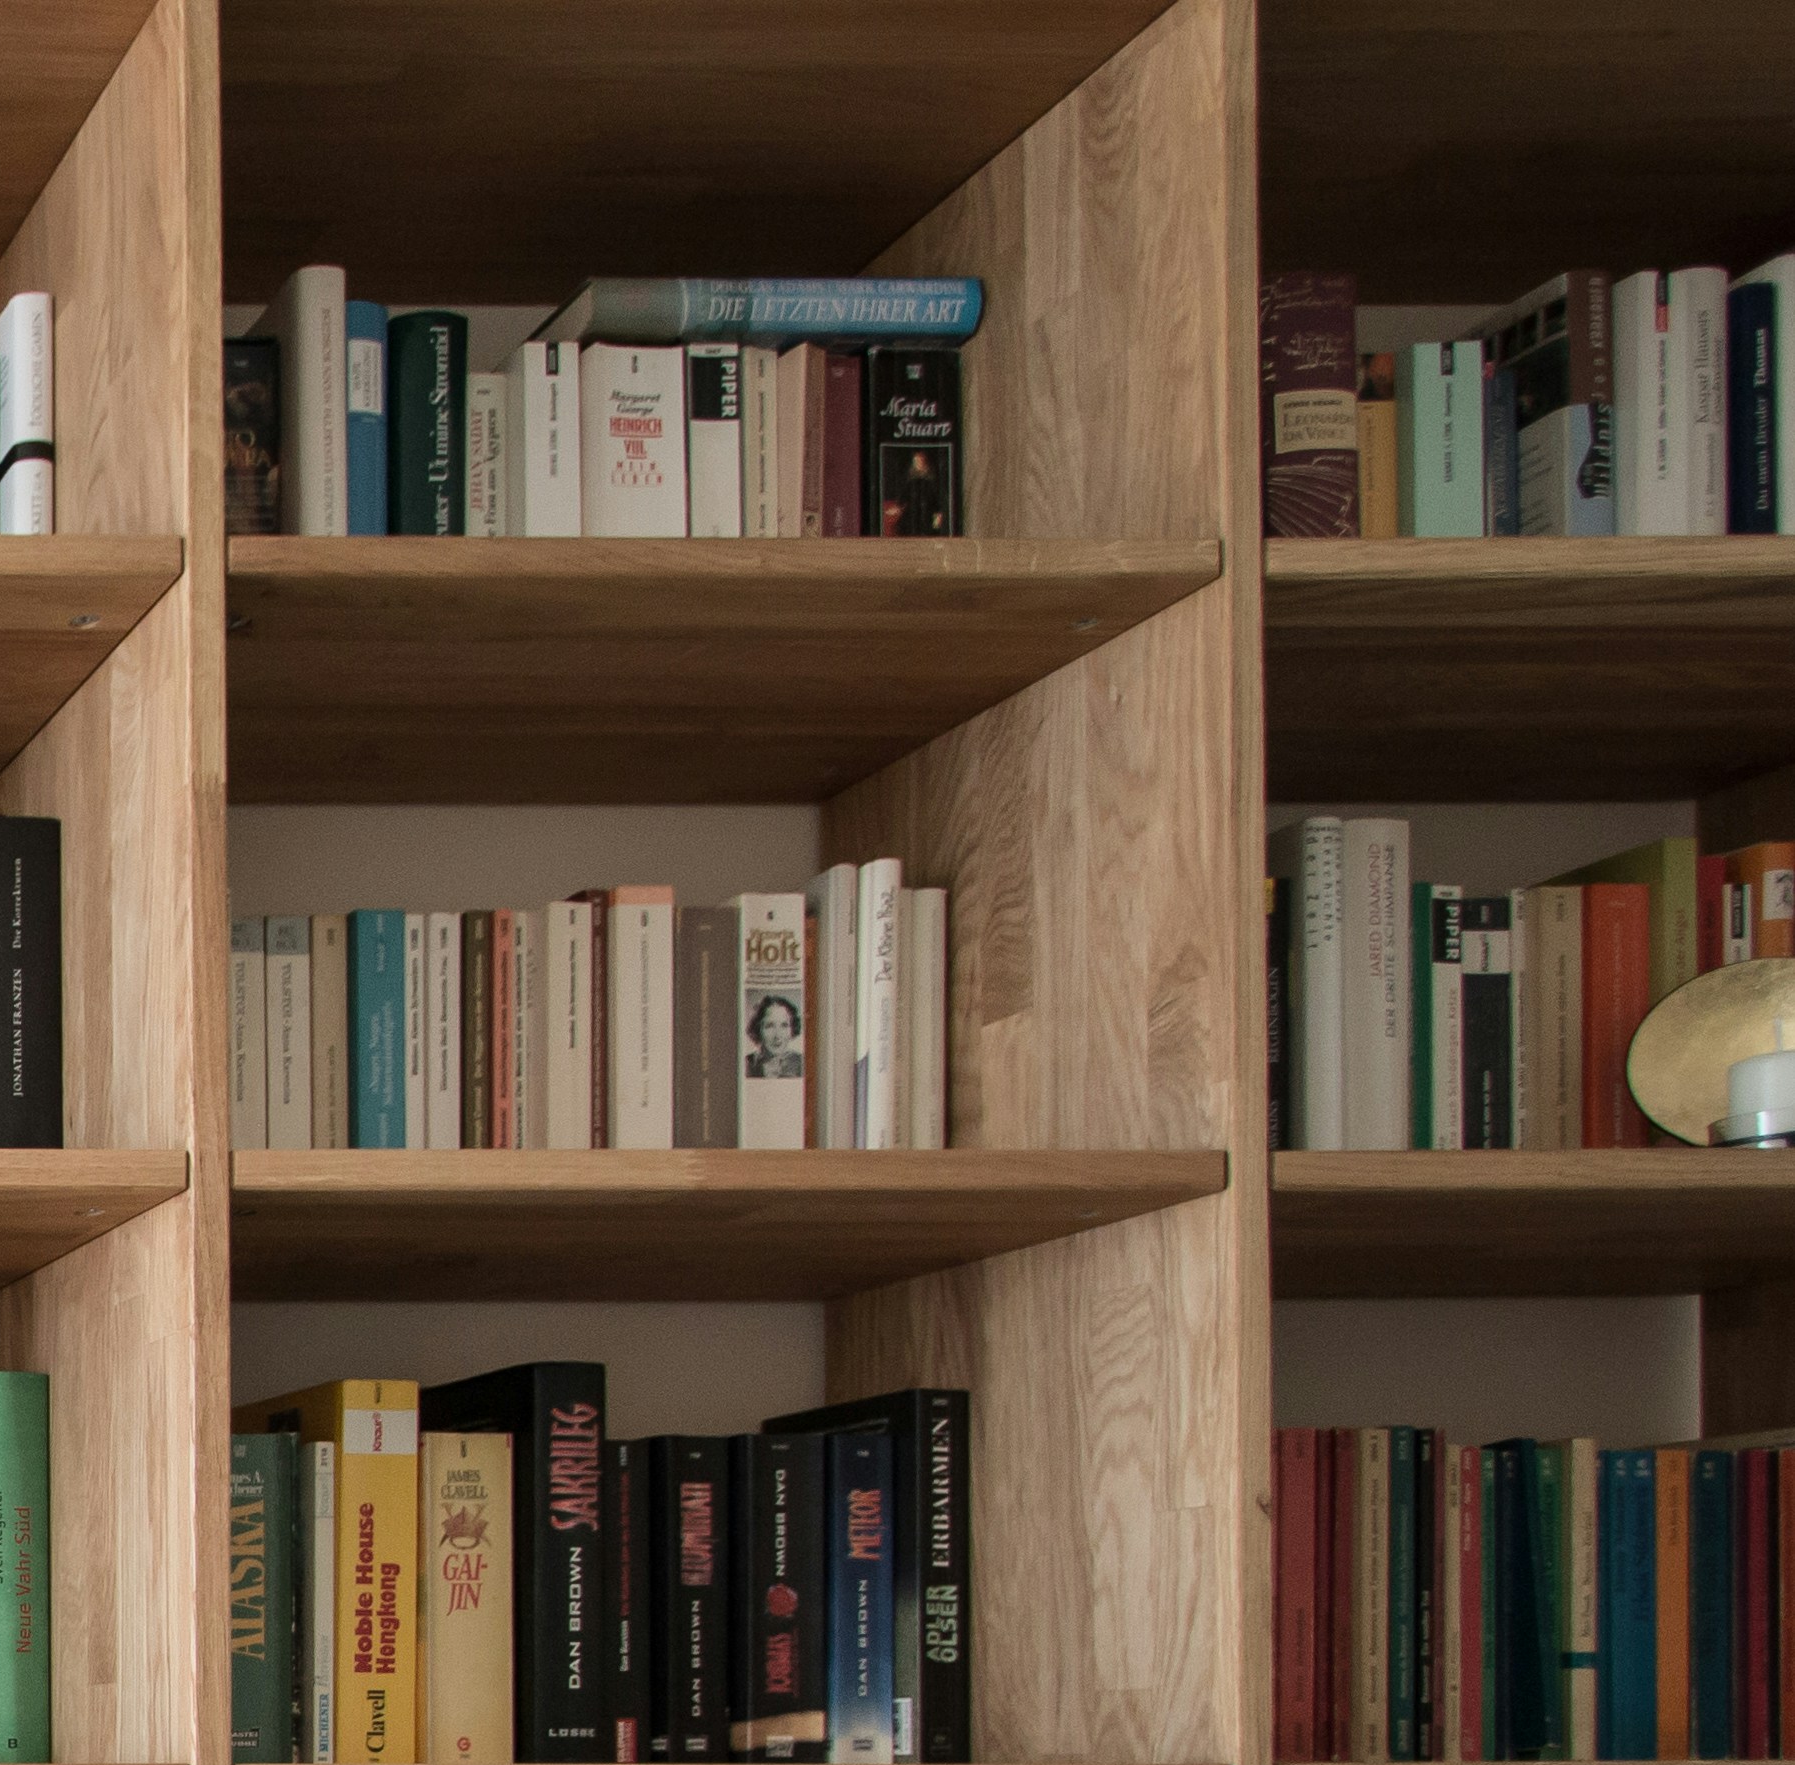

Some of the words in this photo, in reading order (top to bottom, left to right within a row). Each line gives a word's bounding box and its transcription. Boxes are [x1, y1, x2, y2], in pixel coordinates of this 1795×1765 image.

[709, 299, 744, 322] DIE
[752, 299, 846, 323] LETZTEN
[852, 300, 919, 324] IHRER
[924, 299, 964, 324] ART
[720, 361, 738, 418] PIPER
[1368, 844, 1382, 925] DIAMOND
[1368, 932, 1382, 977] JARED
[12, 968, 22, 1026] FRANZEN
[12, 1030, 23, 1096] JONATHAN
[550, 1403, 601, 1530] SAKRILEG
[932, 1417, 950, 1567] ERBARMEN
[14, 1506, 31, 1545] Süd
[356, 1503, 373, 1585] House
[16, 1551, 31, 1596] Vahr
[569, 1547, 582, 1631] BROWN
[16, 1602, 32, 1653] Neue
[355, 1593, 373, 1673] Noble
[376, 1563, 399, 1674] Hongkong
[569, 1641, 581, 1688] DAN
